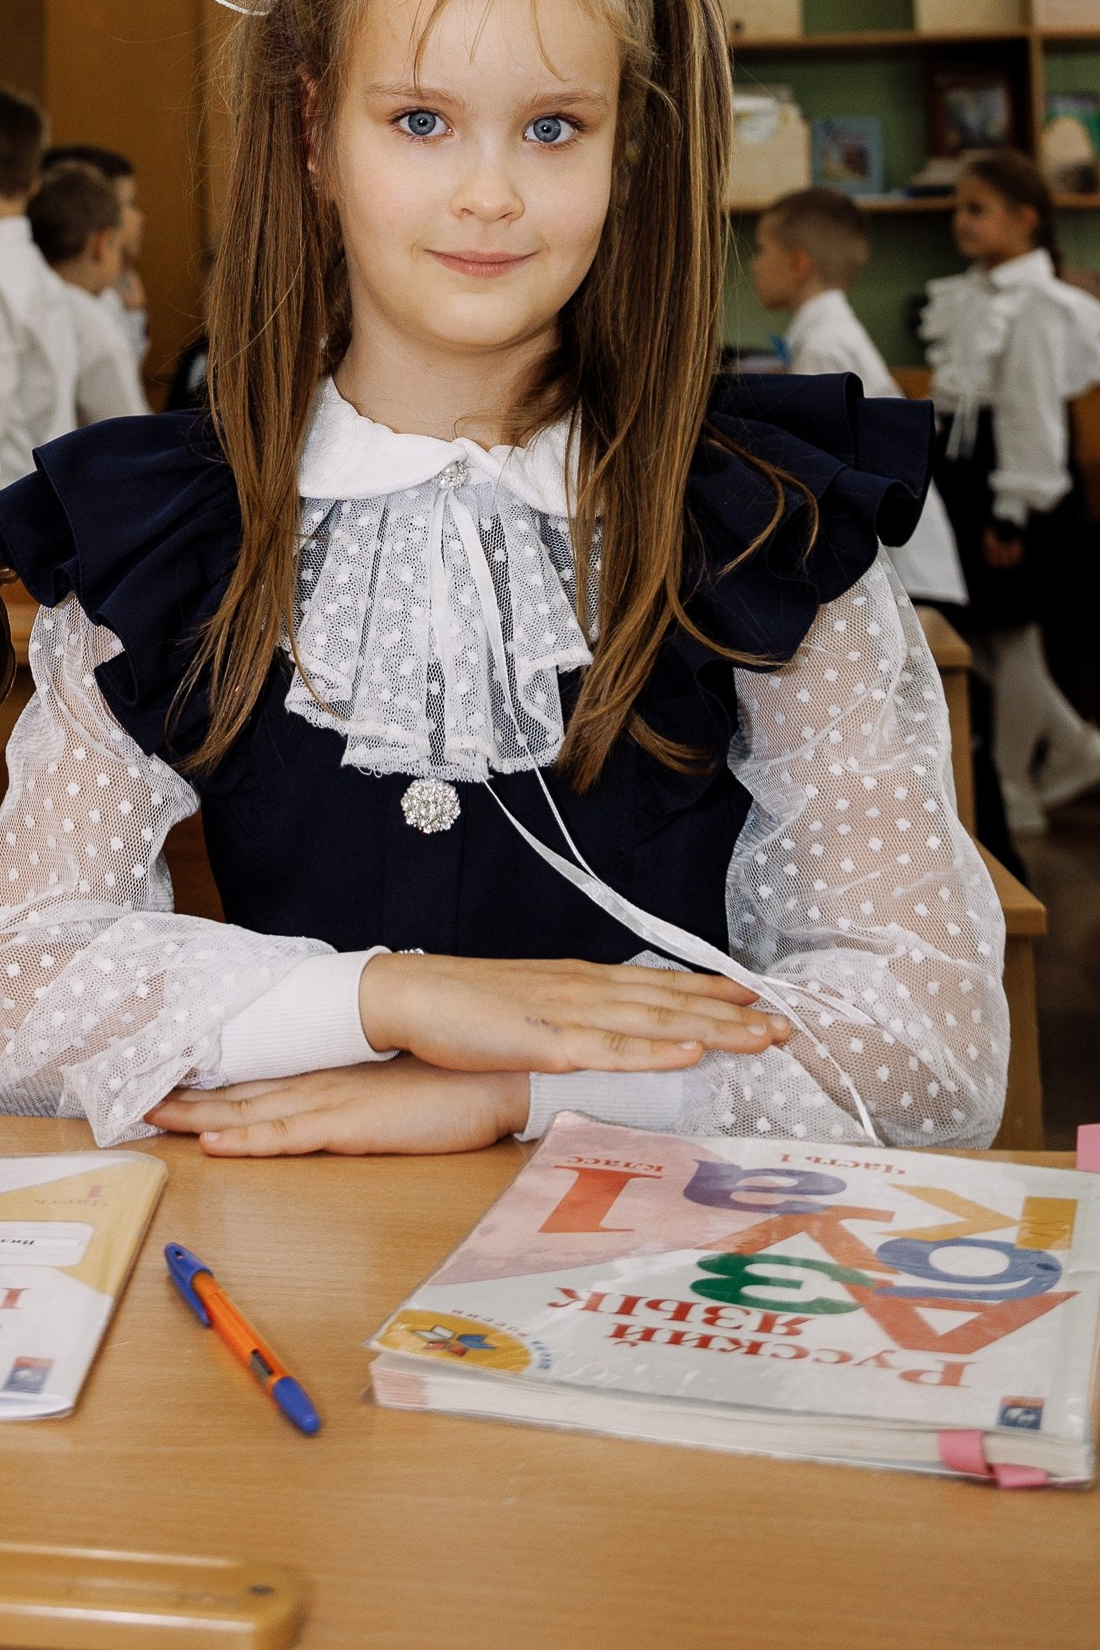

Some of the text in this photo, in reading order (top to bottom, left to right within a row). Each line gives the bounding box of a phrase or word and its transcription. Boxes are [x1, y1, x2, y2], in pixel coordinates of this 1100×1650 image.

[565, 1155, 665, 1174] класс
[537, 1164, 663, 1234] 1
[604, 1322, 977, 1389] Русский
